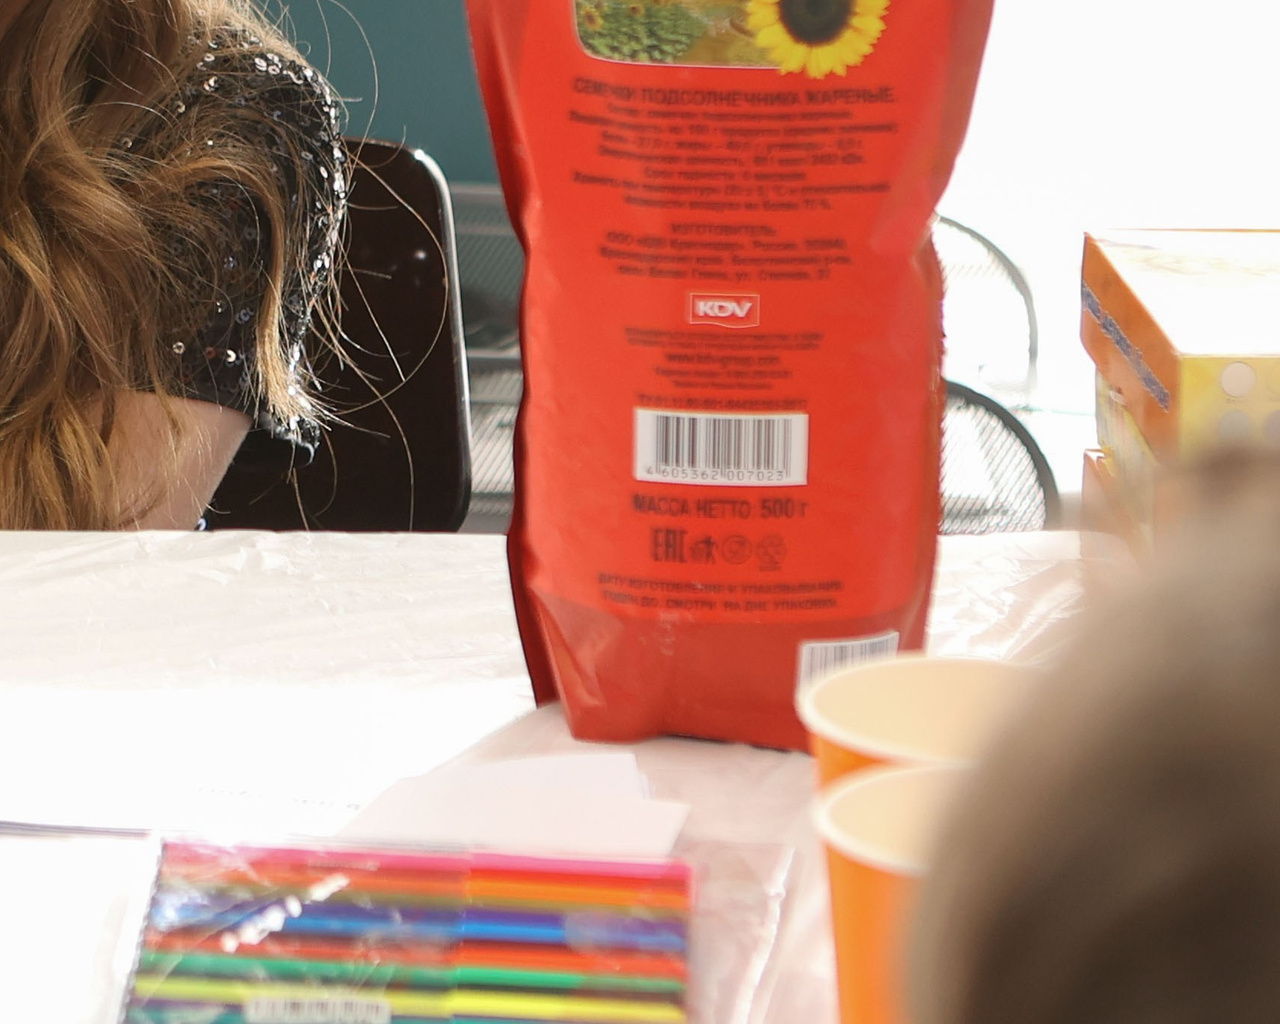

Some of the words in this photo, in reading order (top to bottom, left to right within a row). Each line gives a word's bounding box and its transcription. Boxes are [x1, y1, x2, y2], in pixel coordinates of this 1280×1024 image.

[697, 300, 753, 318] KDV
[632, 493, 689, 517] МАССА
[759, 497, 795, 518] 500
